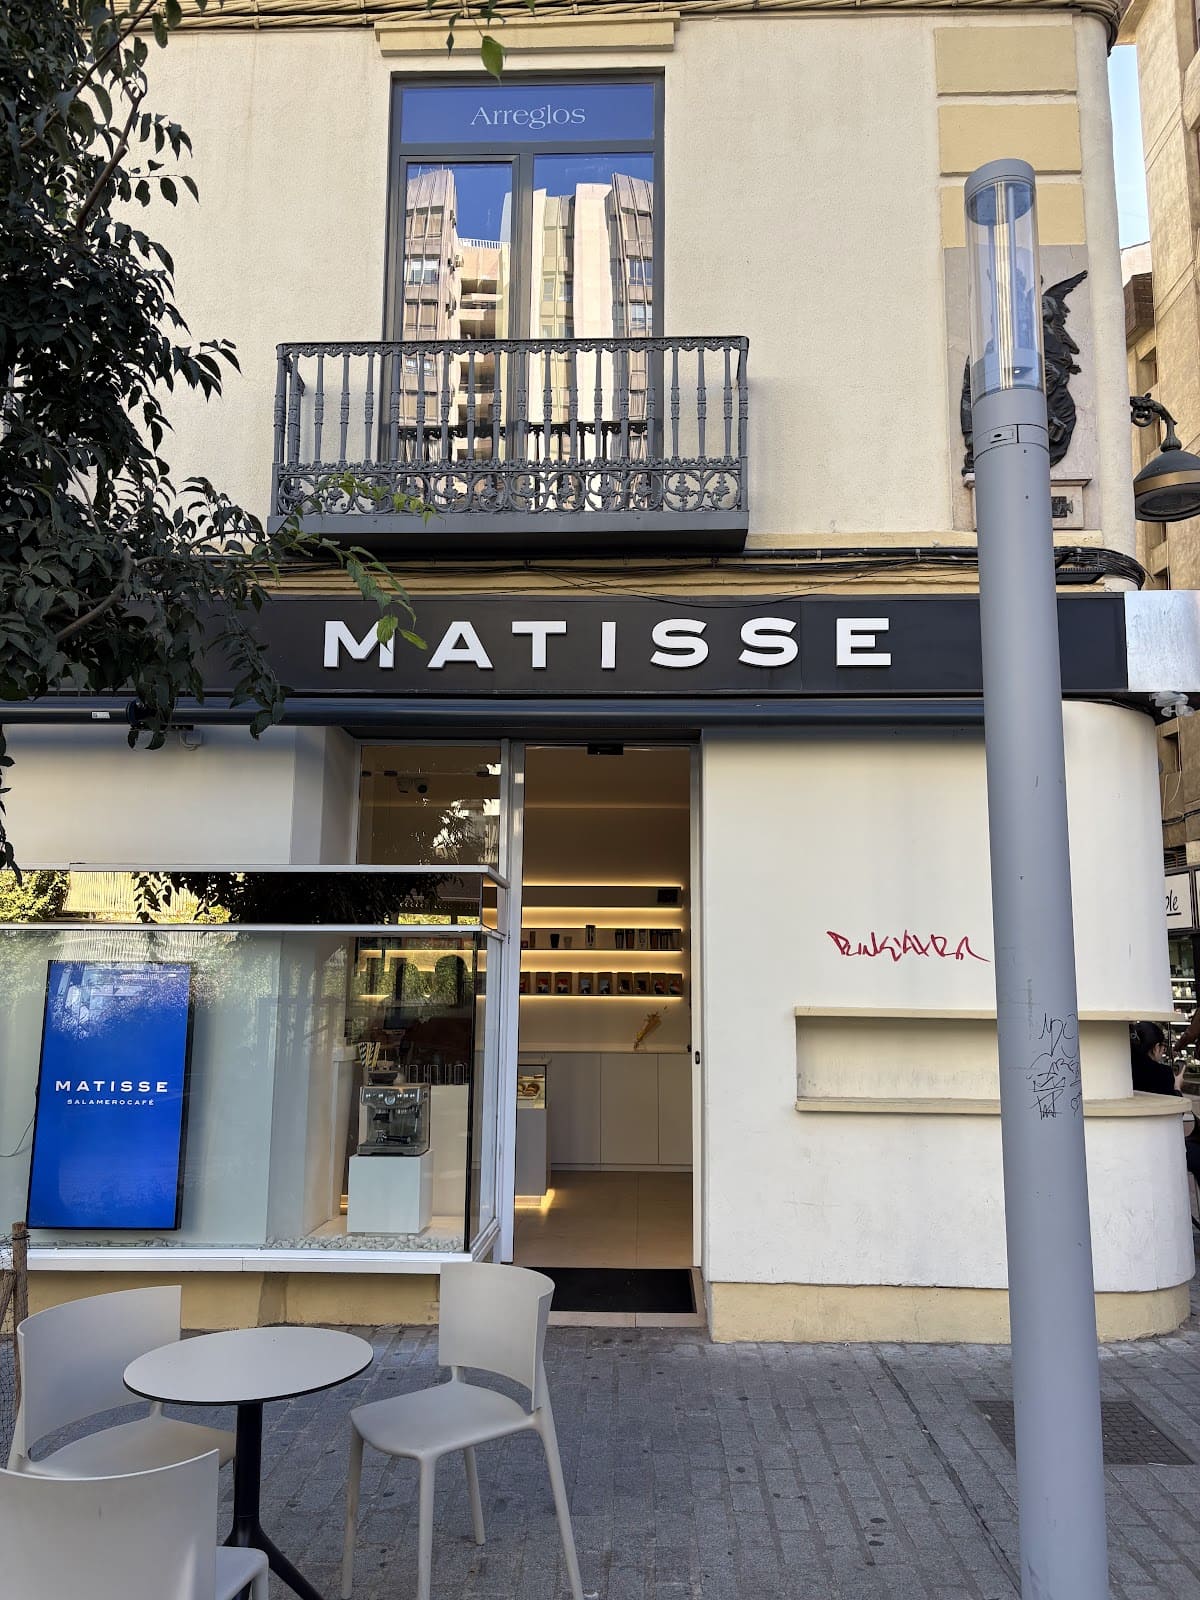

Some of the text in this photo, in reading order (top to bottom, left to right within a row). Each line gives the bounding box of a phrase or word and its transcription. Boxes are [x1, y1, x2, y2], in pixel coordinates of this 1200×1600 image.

[470, 104, 586, 130] Arreglos
[322, 617, 893, 670] MATISSE
[55, 1080, 168, 1093] MATISSE
